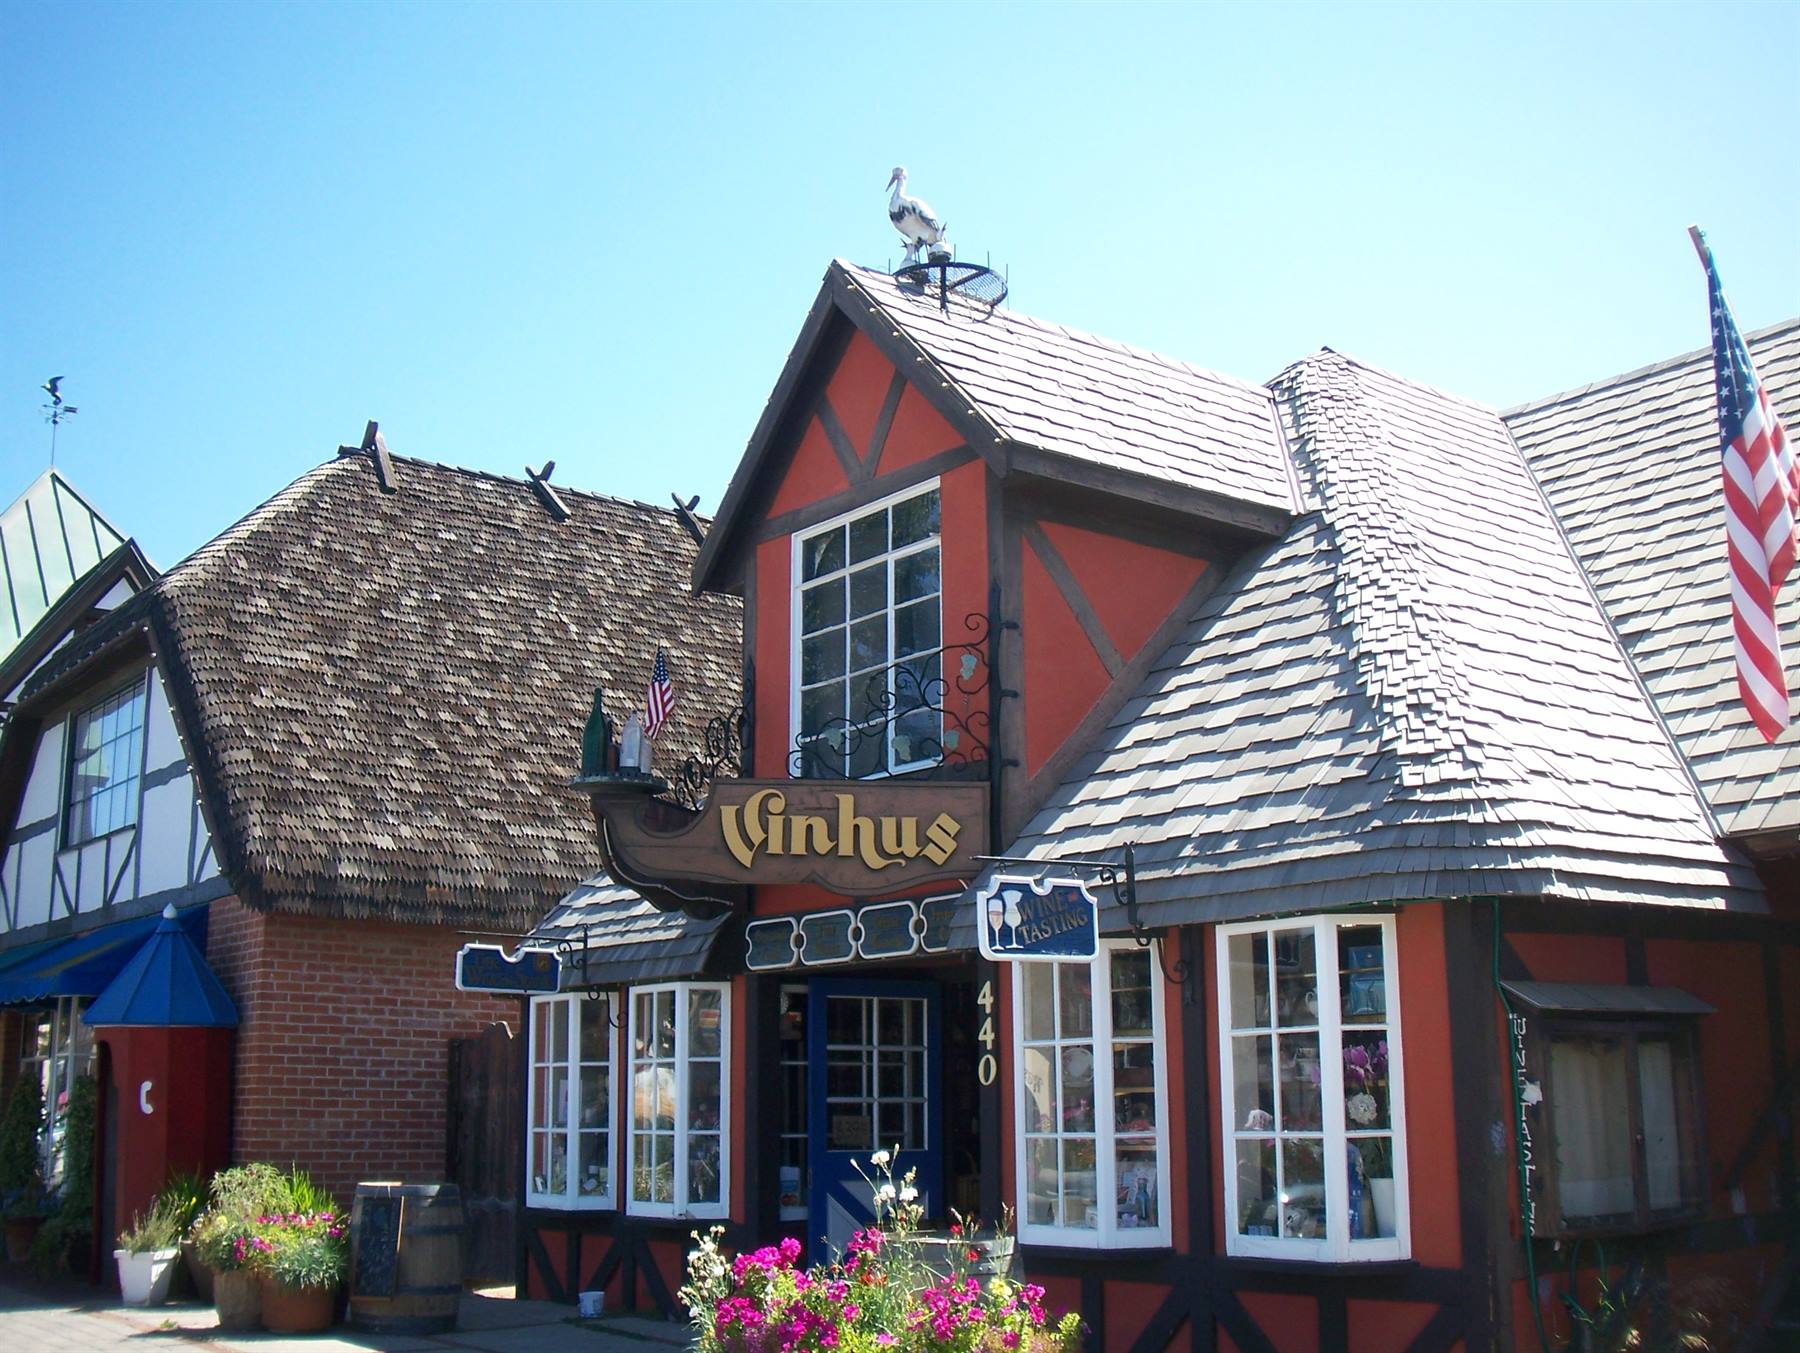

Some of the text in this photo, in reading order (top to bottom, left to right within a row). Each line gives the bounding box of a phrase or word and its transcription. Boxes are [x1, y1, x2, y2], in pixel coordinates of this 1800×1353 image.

[720, 788, 961, 869] Vinhus
[1017, 890, 1068, 922] WINE
[1018, 906, 1088, 945] TASTING
[976, 980, 998, 1087] 440
